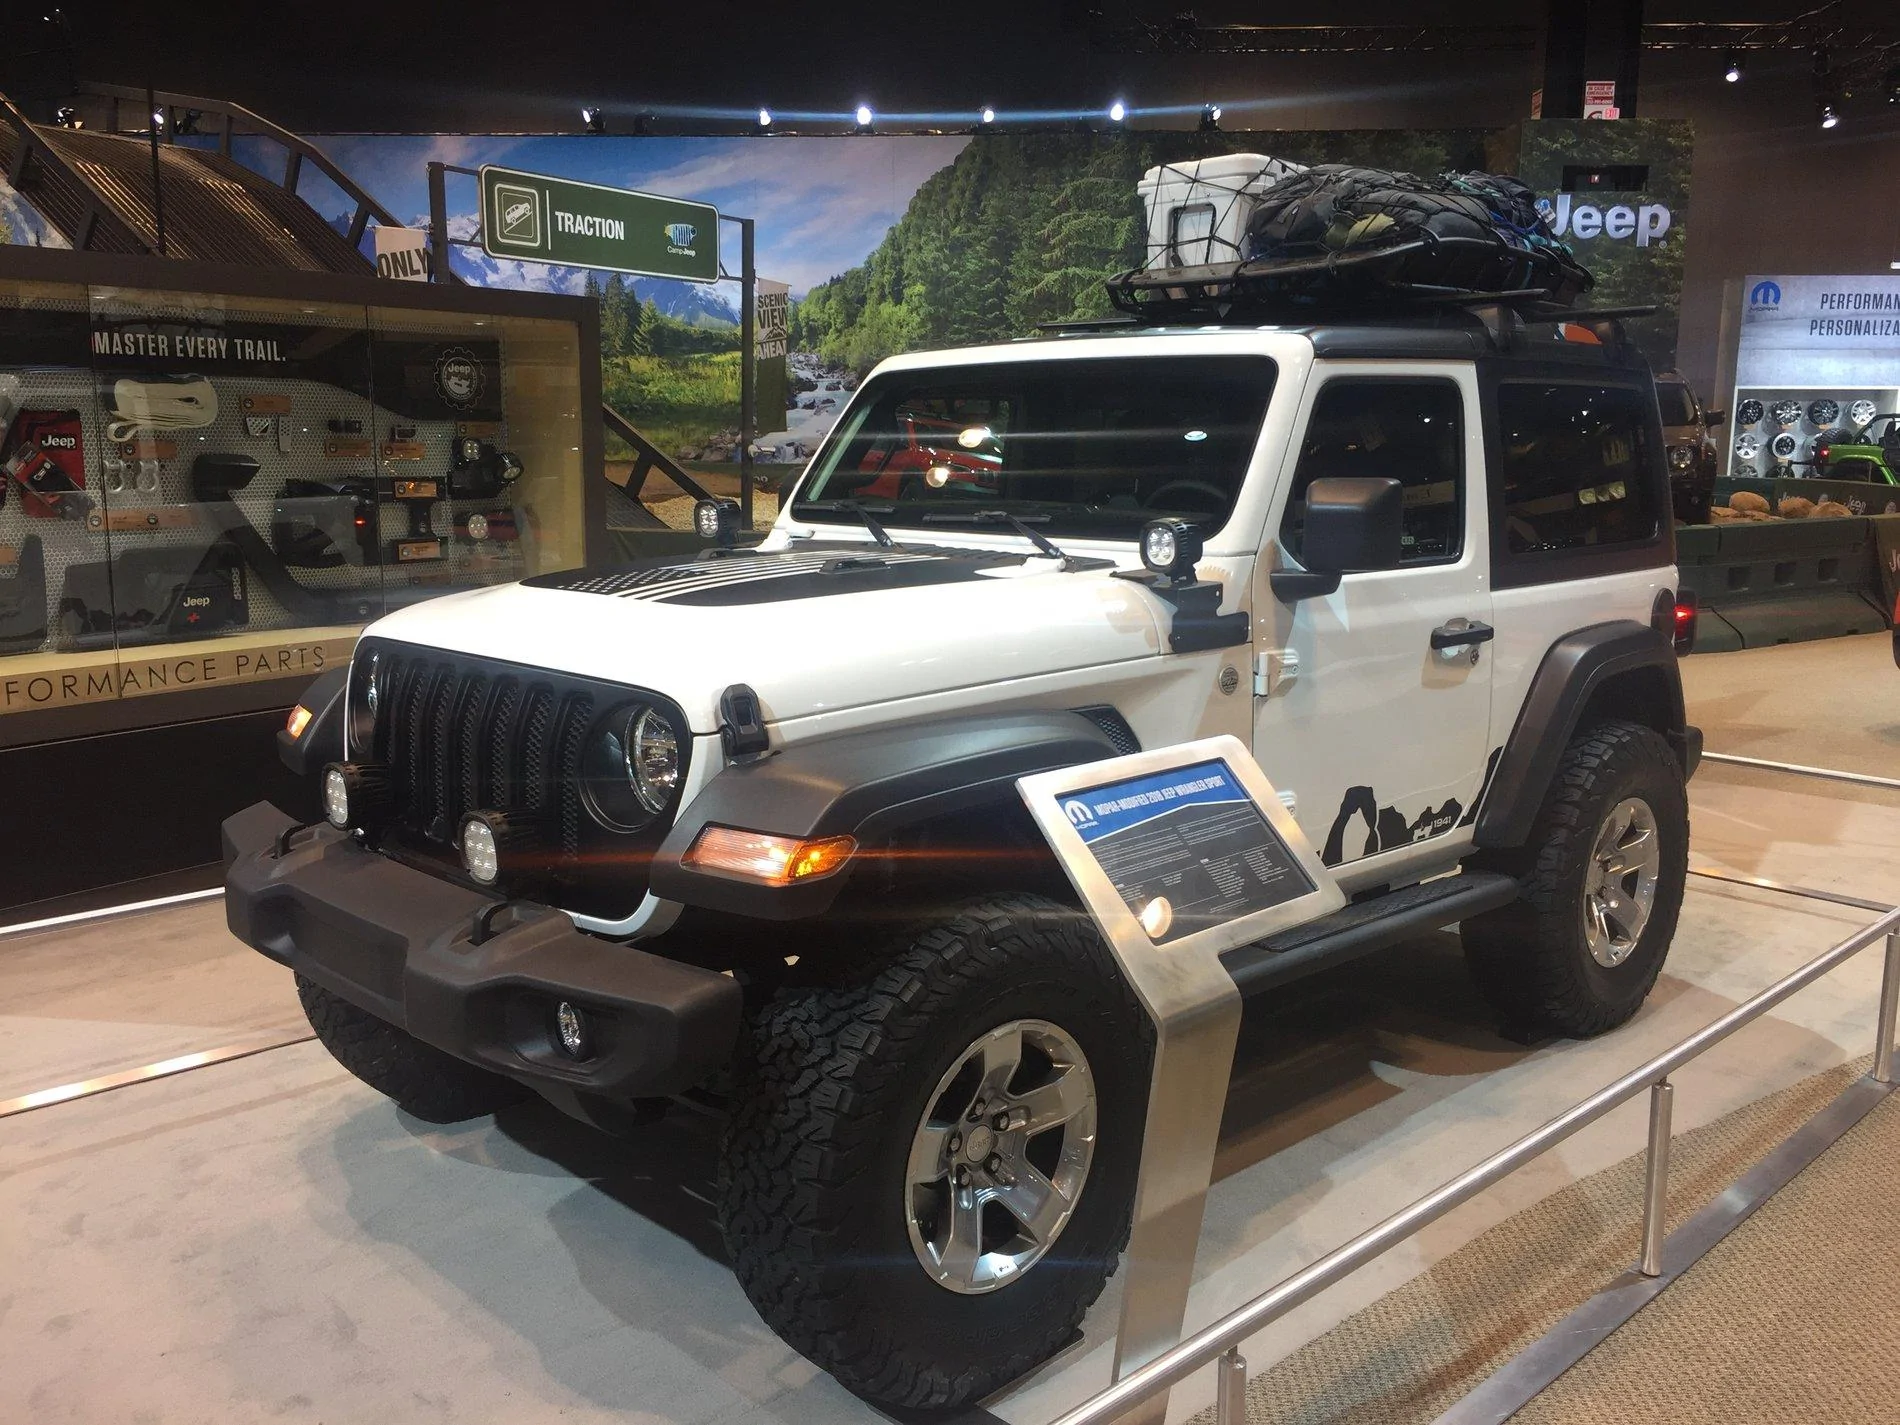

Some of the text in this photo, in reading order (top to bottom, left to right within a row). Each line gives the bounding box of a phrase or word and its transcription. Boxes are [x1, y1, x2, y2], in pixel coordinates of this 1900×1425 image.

[554, 210, 625, 240] TRACTION
[1551, 194, 1671, 247] Jeep
[376, 247, 428, 280] ONLY
[757, 292, 789, 309] SCENIC
[757, 306, 788, 329] VIEW
[1809, 319, 1900, 336] PERSONALIZA
[95, 331, 287, 362] MASTER EVERY TRAIL.
[448, 362, 471, 375] Jeep
[41, 434, 76, 448] Jeep
[183, 596, 210, 607] Jeep
[236, 646, 325, 676] PARTS
[1161, 786, 1178, 800] JEEP
[1204, 775, 1226, 789] SPORT
[1433, 816, 1452, 828] 1941
